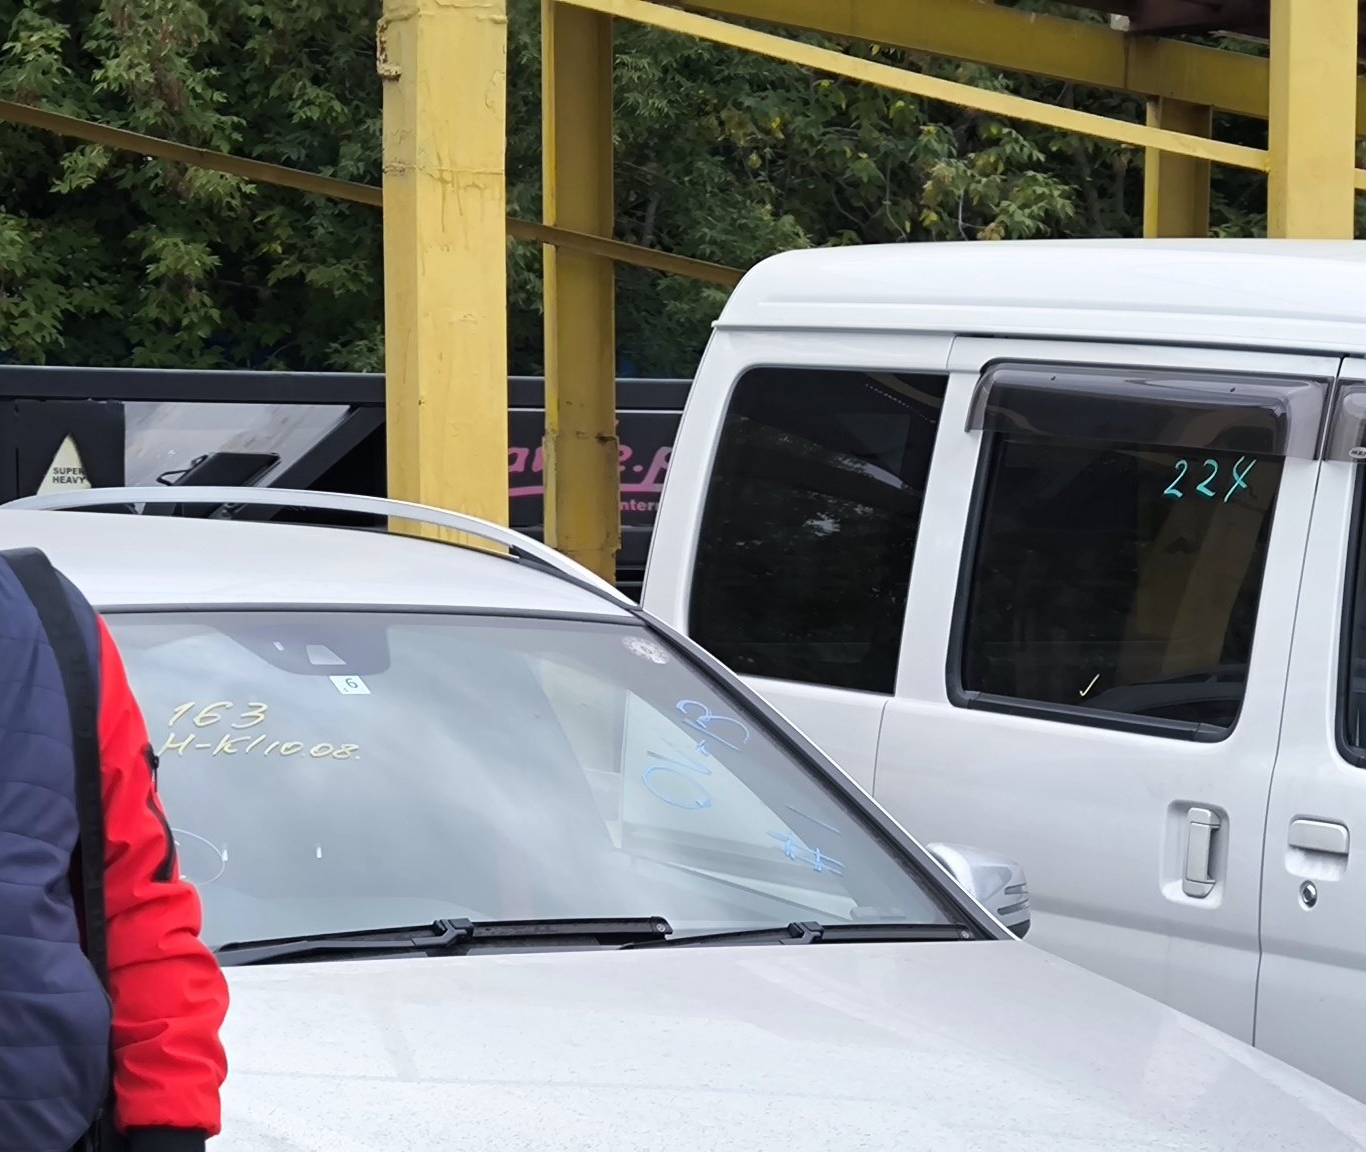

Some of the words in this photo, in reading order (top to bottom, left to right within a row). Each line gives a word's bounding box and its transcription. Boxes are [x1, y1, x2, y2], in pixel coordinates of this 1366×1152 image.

[53, 467, 84, 475] SUPER
[52, 476, 86, 484] HEAVY
[167, 701, 268, 729] 163
